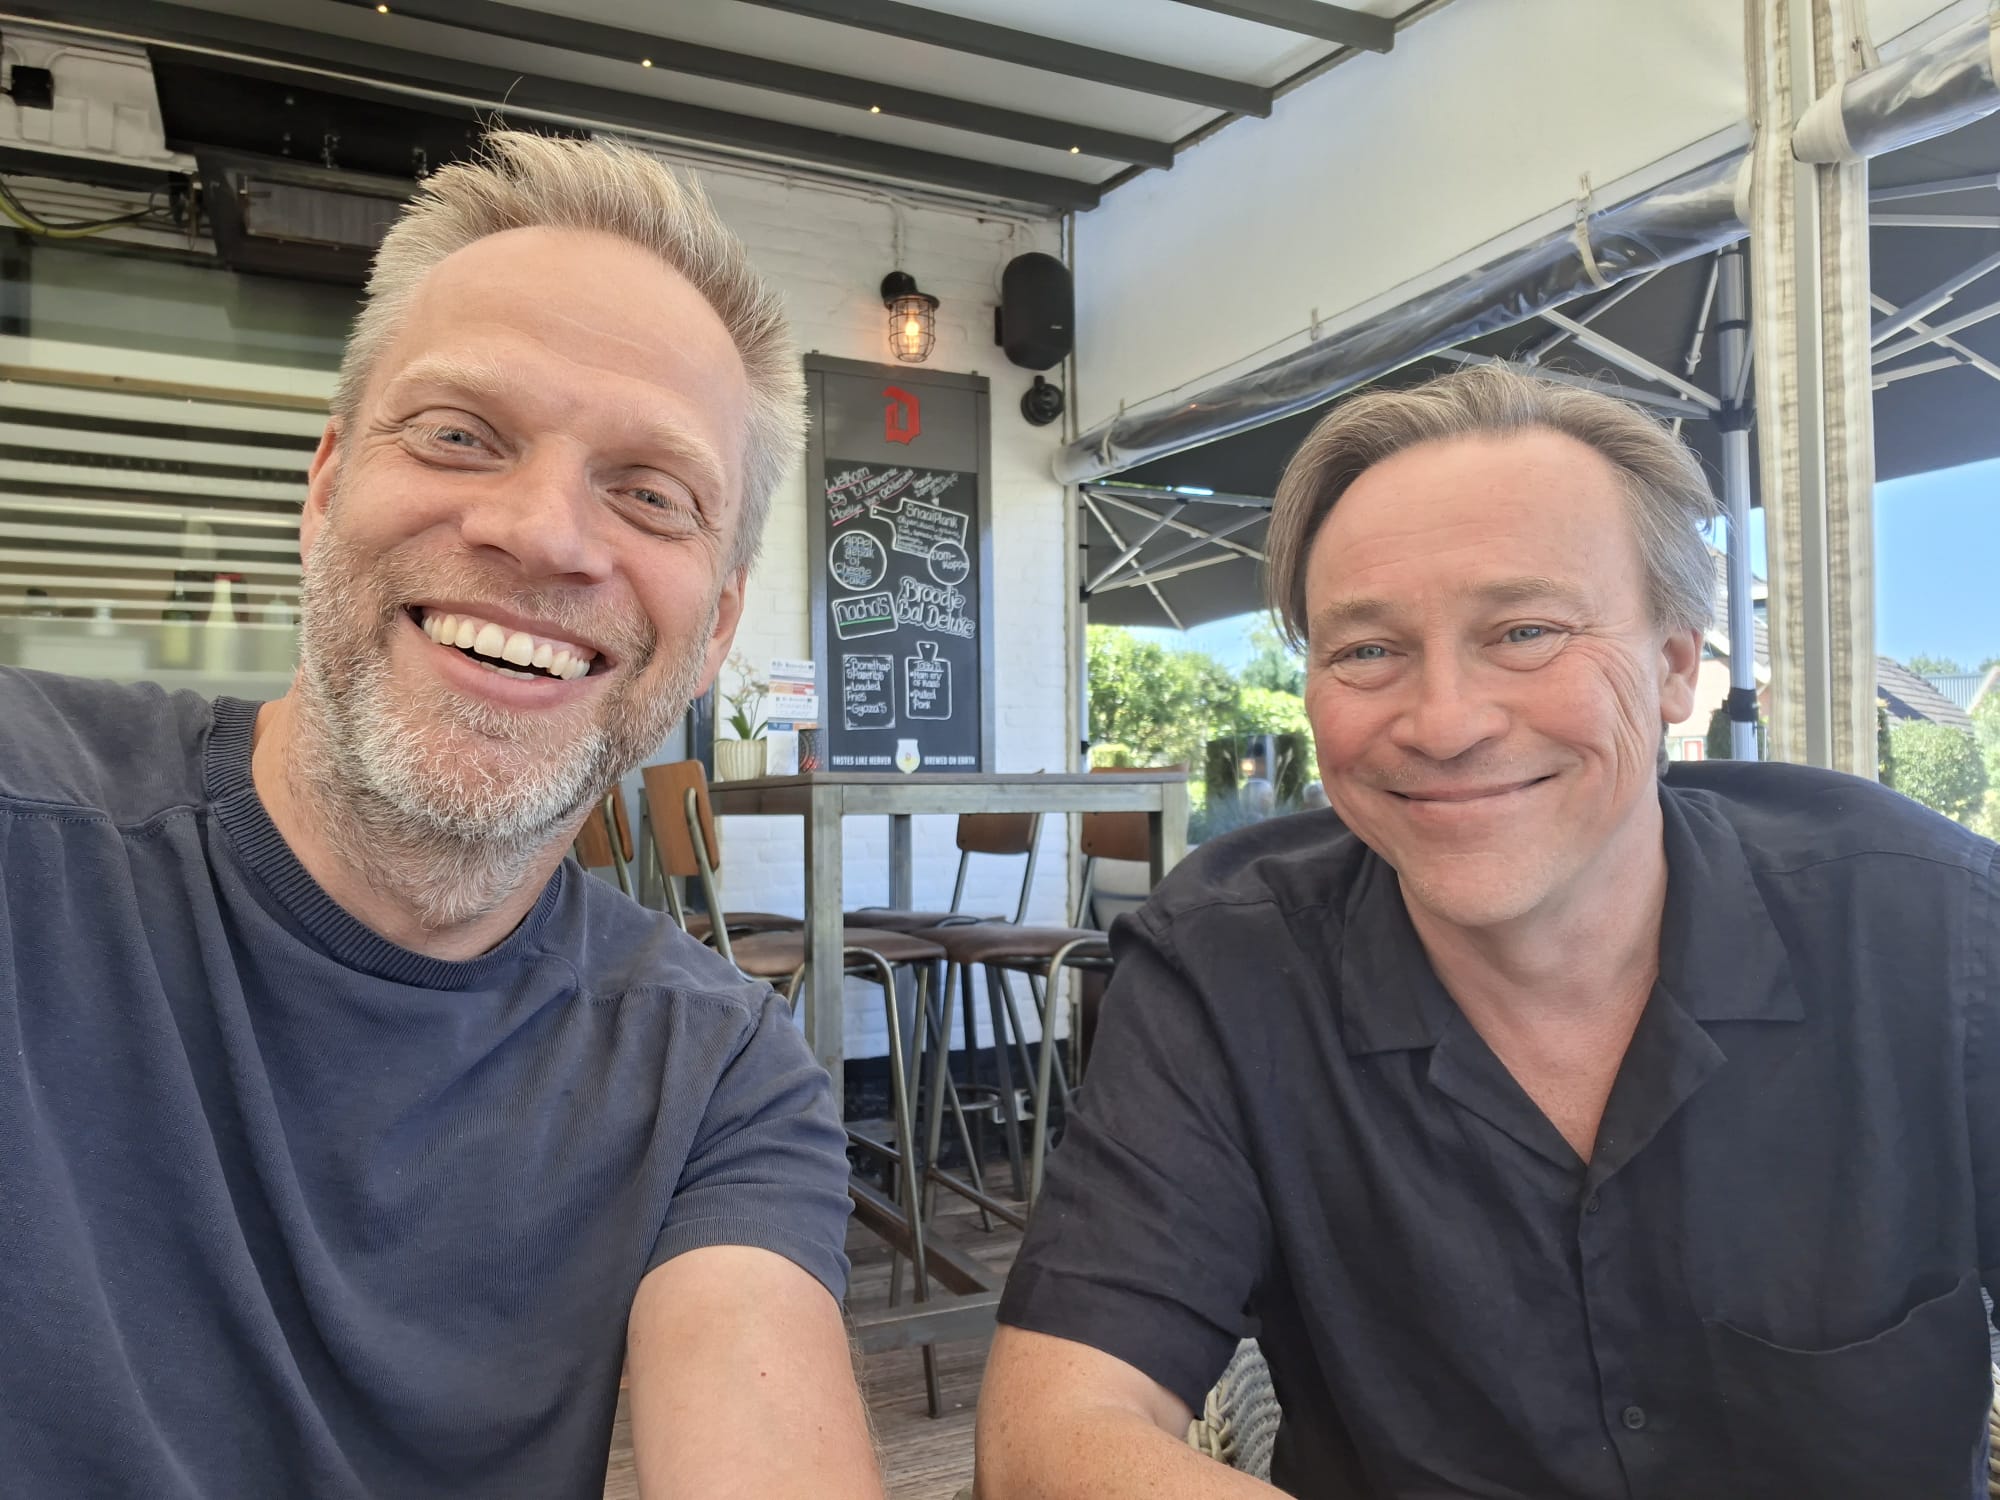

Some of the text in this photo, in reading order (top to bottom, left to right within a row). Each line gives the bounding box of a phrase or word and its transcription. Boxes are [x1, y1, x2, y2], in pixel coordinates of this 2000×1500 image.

[825, 467, 870, 491] Welkom
[901, 578, 963, 612] Broodje
[900, 600, 974, 637] Bal Deluxe
[846, 691, 867, 702] Fries
[913, 688, 936, 700] Pulled
